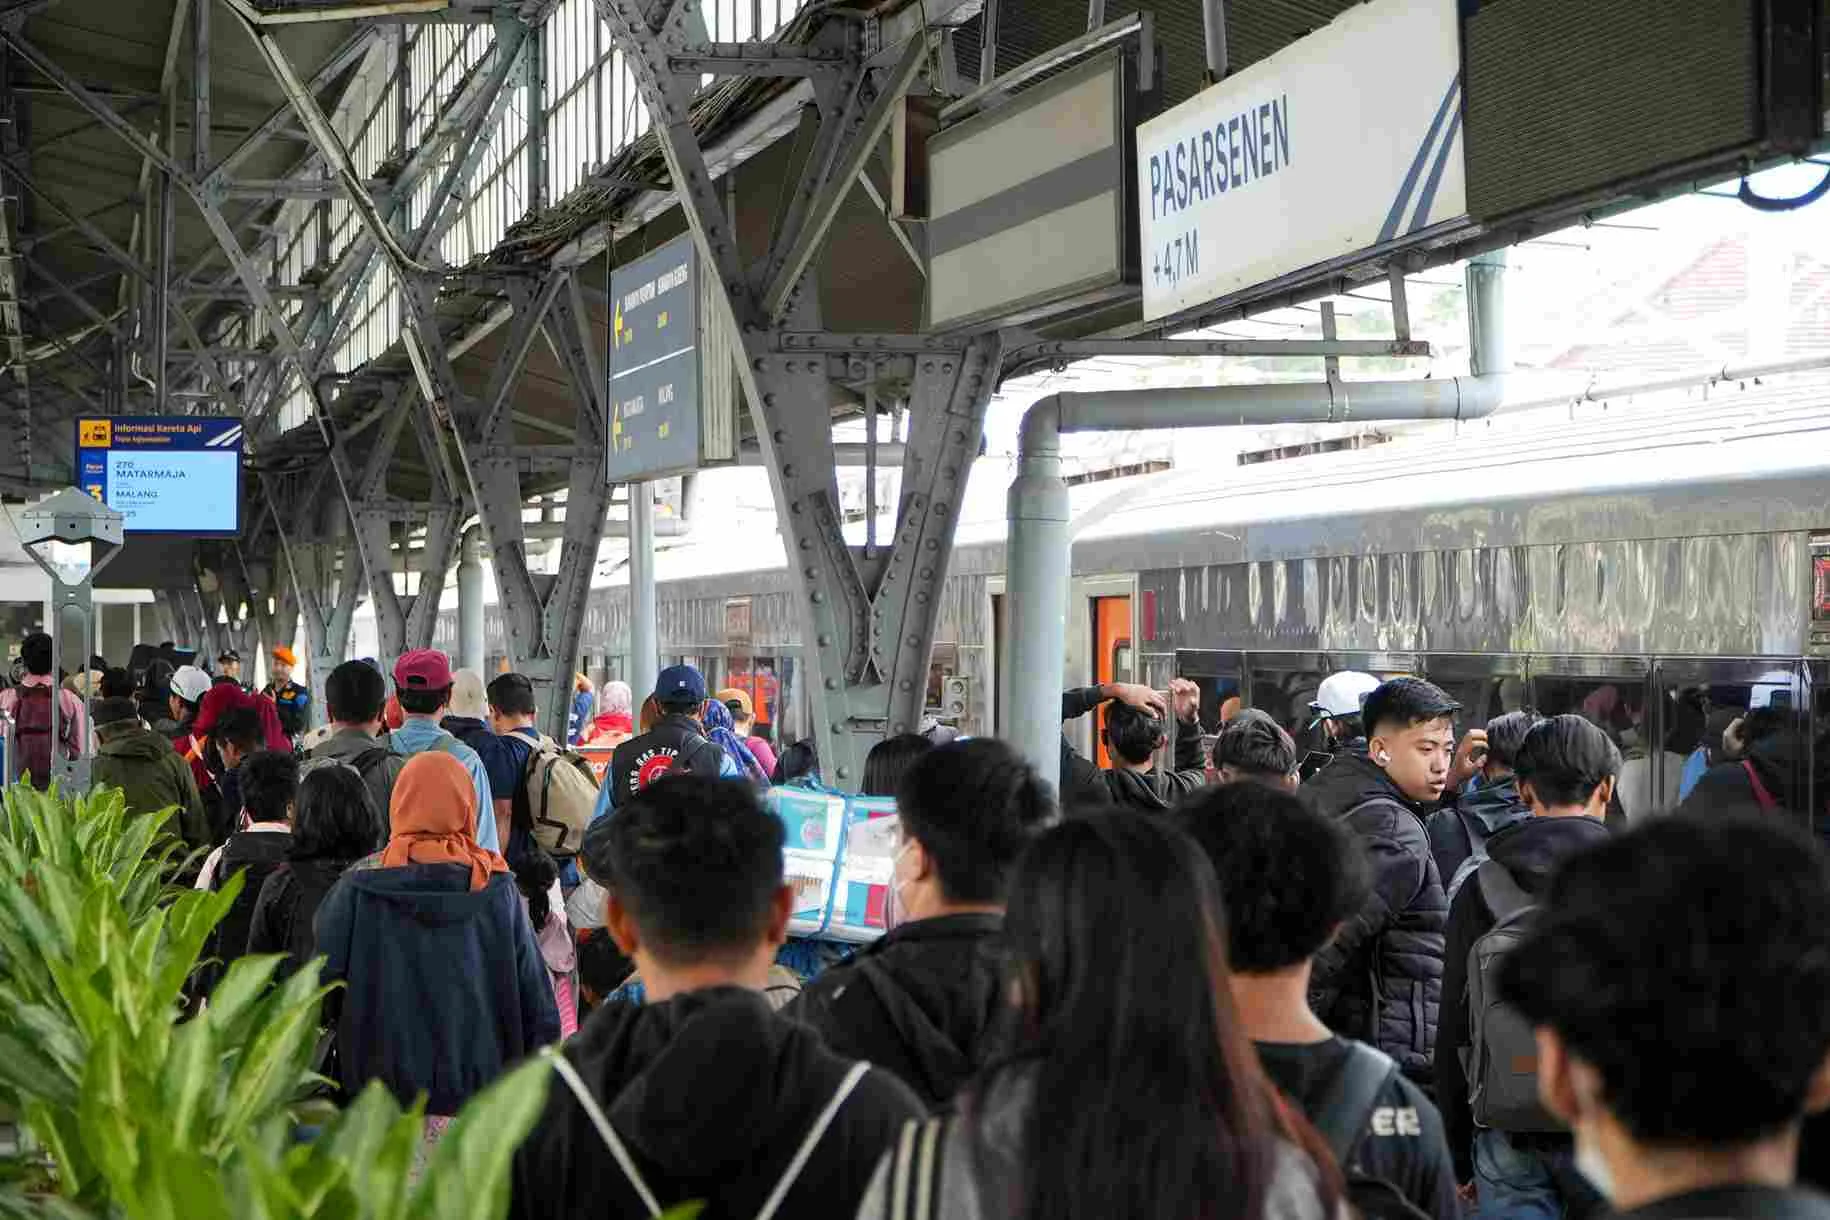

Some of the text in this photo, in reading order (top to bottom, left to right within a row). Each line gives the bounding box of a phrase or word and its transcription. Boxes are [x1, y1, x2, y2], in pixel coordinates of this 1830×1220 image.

[1150, 93, 1289, 221] PASARSENEN
[114, 423, 202, 436] Informasi Kereta Api
[116, 469, 186, 479] MATARMAJA
[116, 490, 159, 499] MALANG
